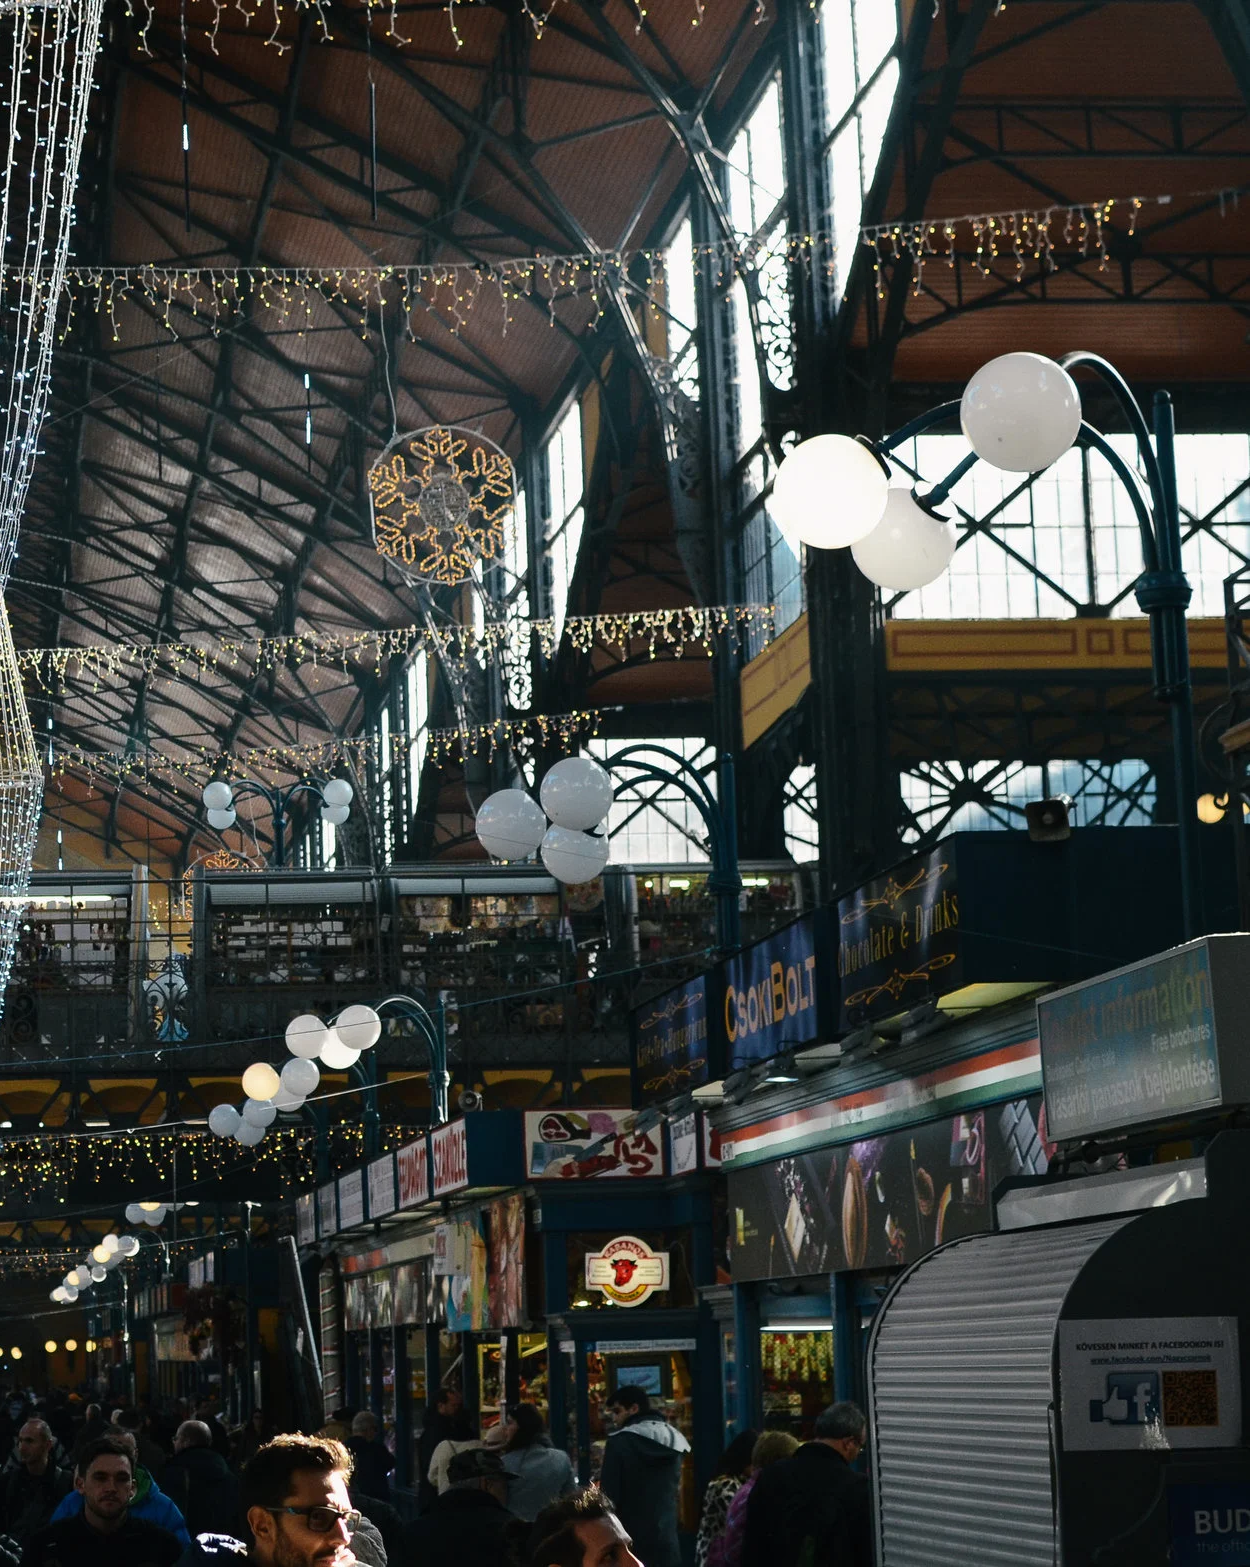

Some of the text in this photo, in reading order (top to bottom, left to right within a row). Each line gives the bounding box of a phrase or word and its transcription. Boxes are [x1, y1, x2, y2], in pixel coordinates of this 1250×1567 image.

[838, 925, 894, 978] Chocolate
[900, 911, 909, 949] &
[1101, 962, 1210, 1035] information
[1151, 1022, 1211, 1054] Free brochures
[1144, 1055, 1216, 1104] bejelentése
[1076, 1340, 1224, 1351] KÖVESSEN MINKET A FACEBOOKON IS!
[1193, 1508, 1250, 1535] BUD
